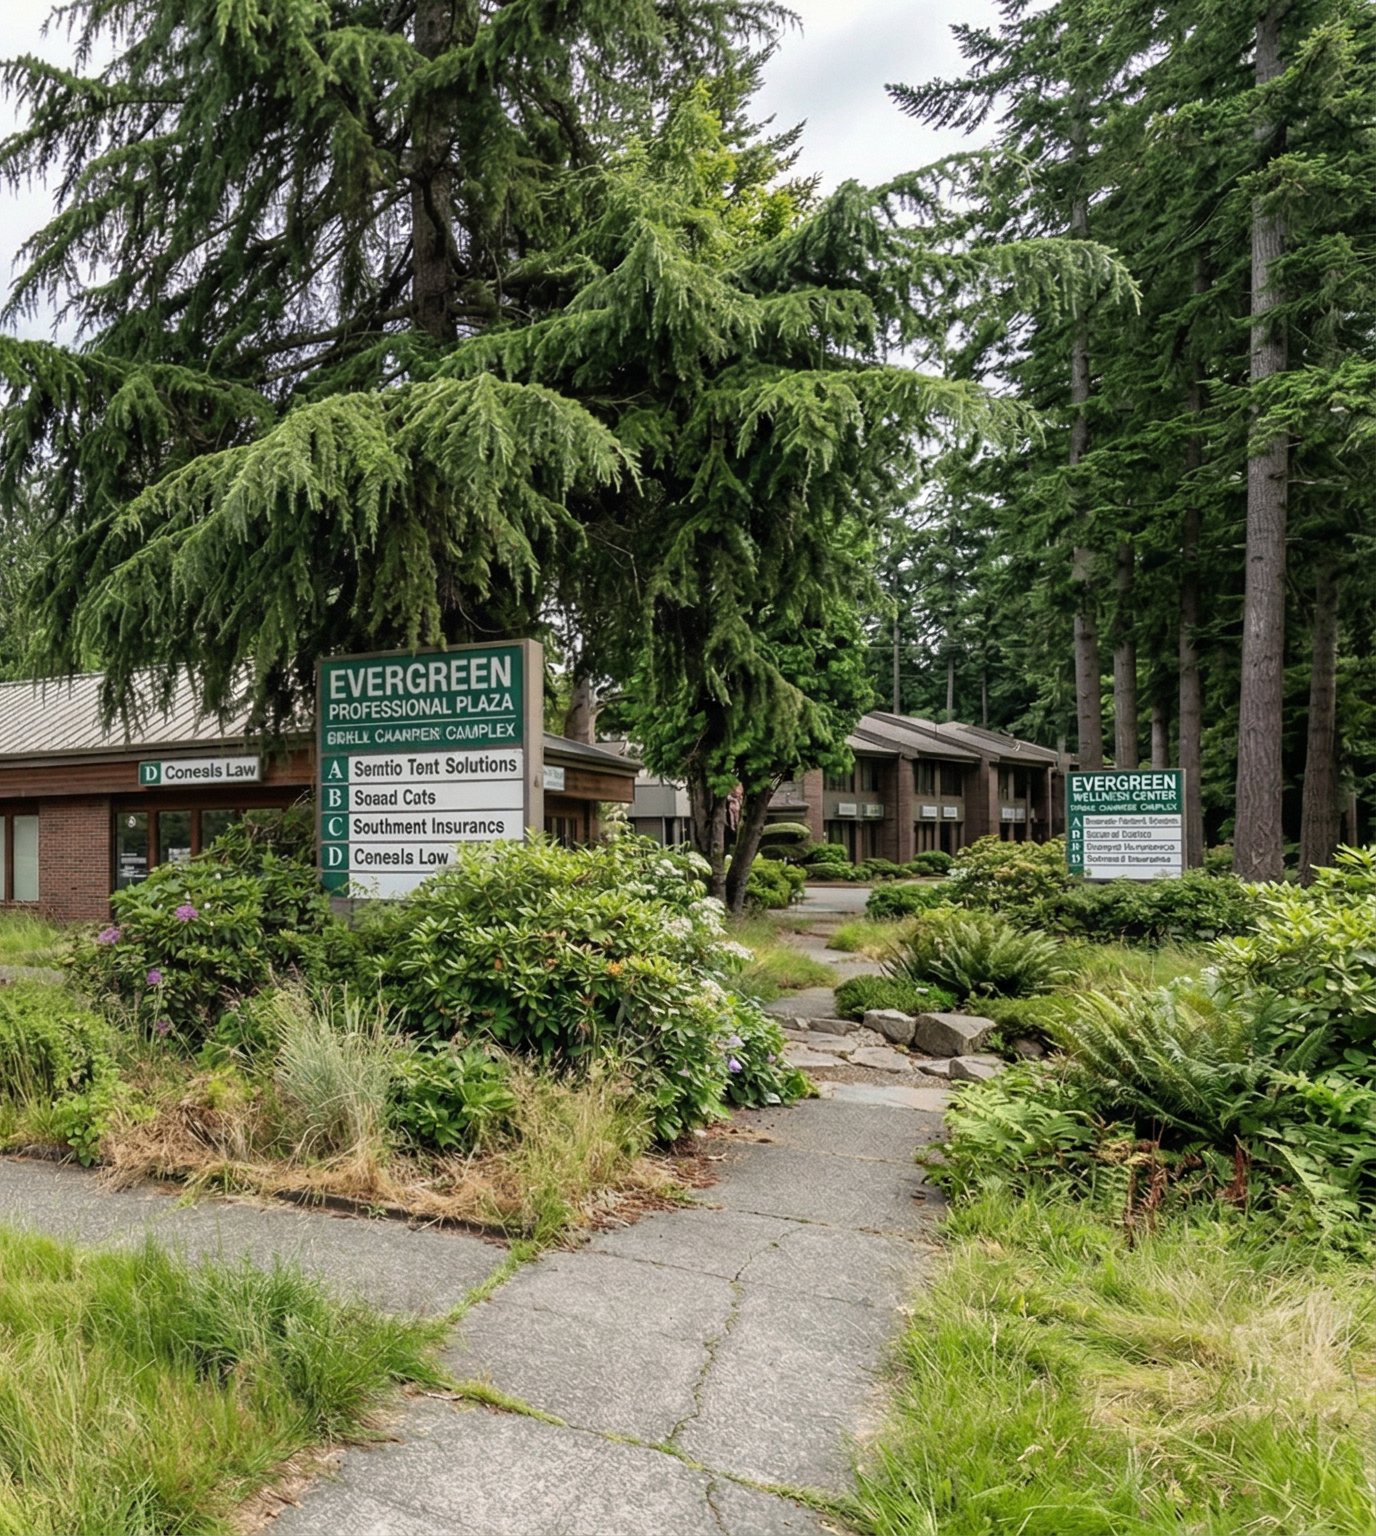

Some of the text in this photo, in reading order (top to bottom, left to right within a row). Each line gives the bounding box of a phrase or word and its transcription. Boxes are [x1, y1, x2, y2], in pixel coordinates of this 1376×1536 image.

[329, 655, 512, 700] EVERGREEN
[329, 692, 514, 720] PROFESSIONAL PLAZA
[145, 766, 158, 781] D
[226, 762, 256, 777] Law
[327, 760, 343, 779] A
[445, 756, 517, 774] Solutions
[1072, 774, 1177, 792] EVERGREEN
[328, 788, 342, 808] B
[1132, 790, 1177, 801] CENTER
[328, 817, 343, 837] C
[353, 818, 428, 835] Southment
[328, 847, 343, 866] D
